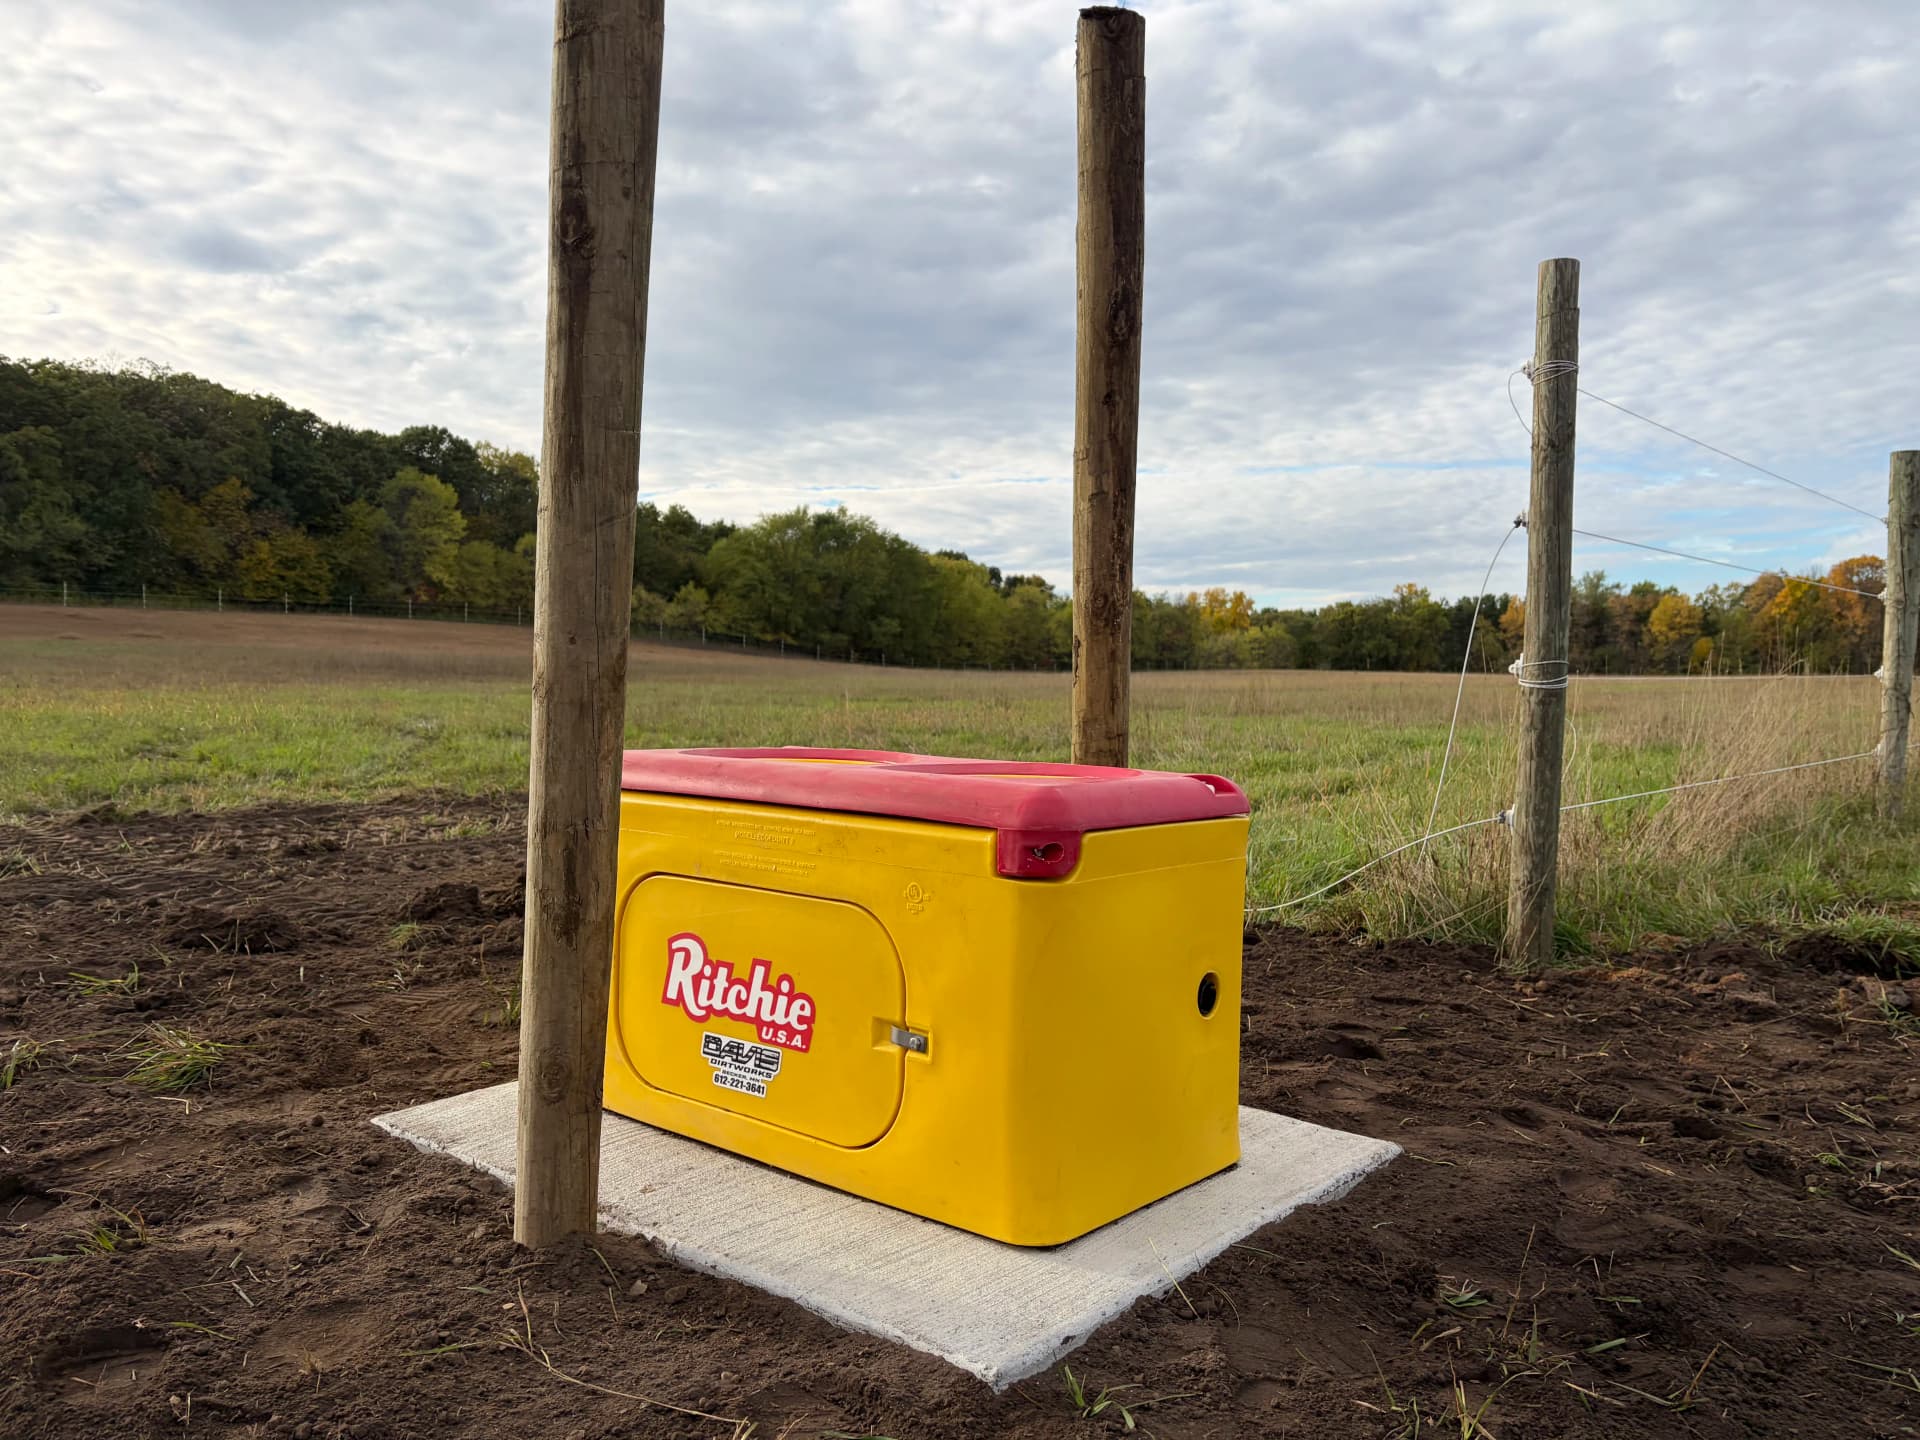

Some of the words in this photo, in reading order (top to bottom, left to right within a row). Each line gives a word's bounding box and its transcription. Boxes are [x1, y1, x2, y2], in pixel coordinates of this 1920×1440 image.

[665, 937, 811, 1031] Ritchie
[761, 1027, 806, 1049] U.S.A.
[703, 1034, 780, 1072] DAVIS
[710, 1058, 772, 1079] DIRTWORKS
[714, 1074, 765, 1095] 612-221-3641
